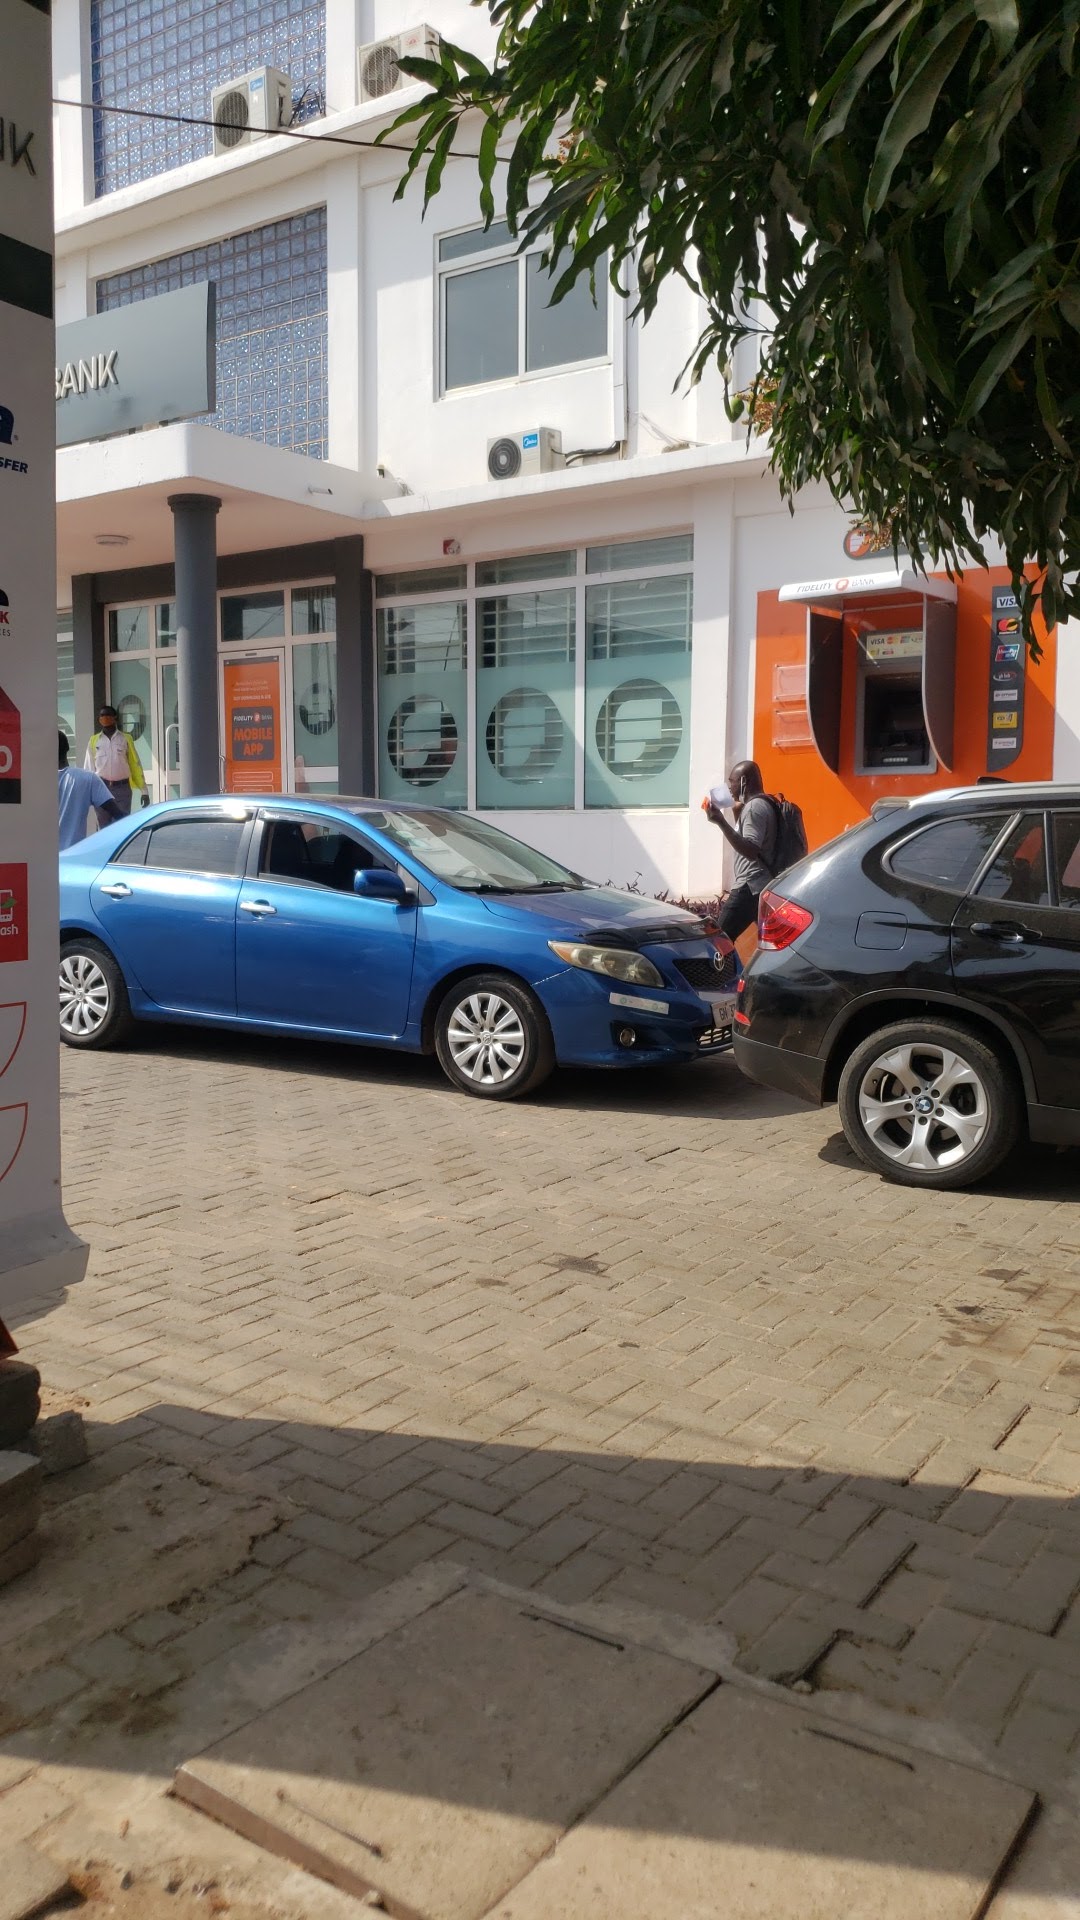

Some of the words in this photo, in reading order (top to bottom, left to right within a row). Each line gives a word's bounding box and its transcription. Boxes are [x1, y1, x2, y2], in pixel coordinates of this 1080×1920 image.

[797, 582, 832, 593] FIDELITY
[998, 597, 1017, 607] VIS
[234, 727, 272, 740] MOBILE
[243, 743, 264, 756] APP
